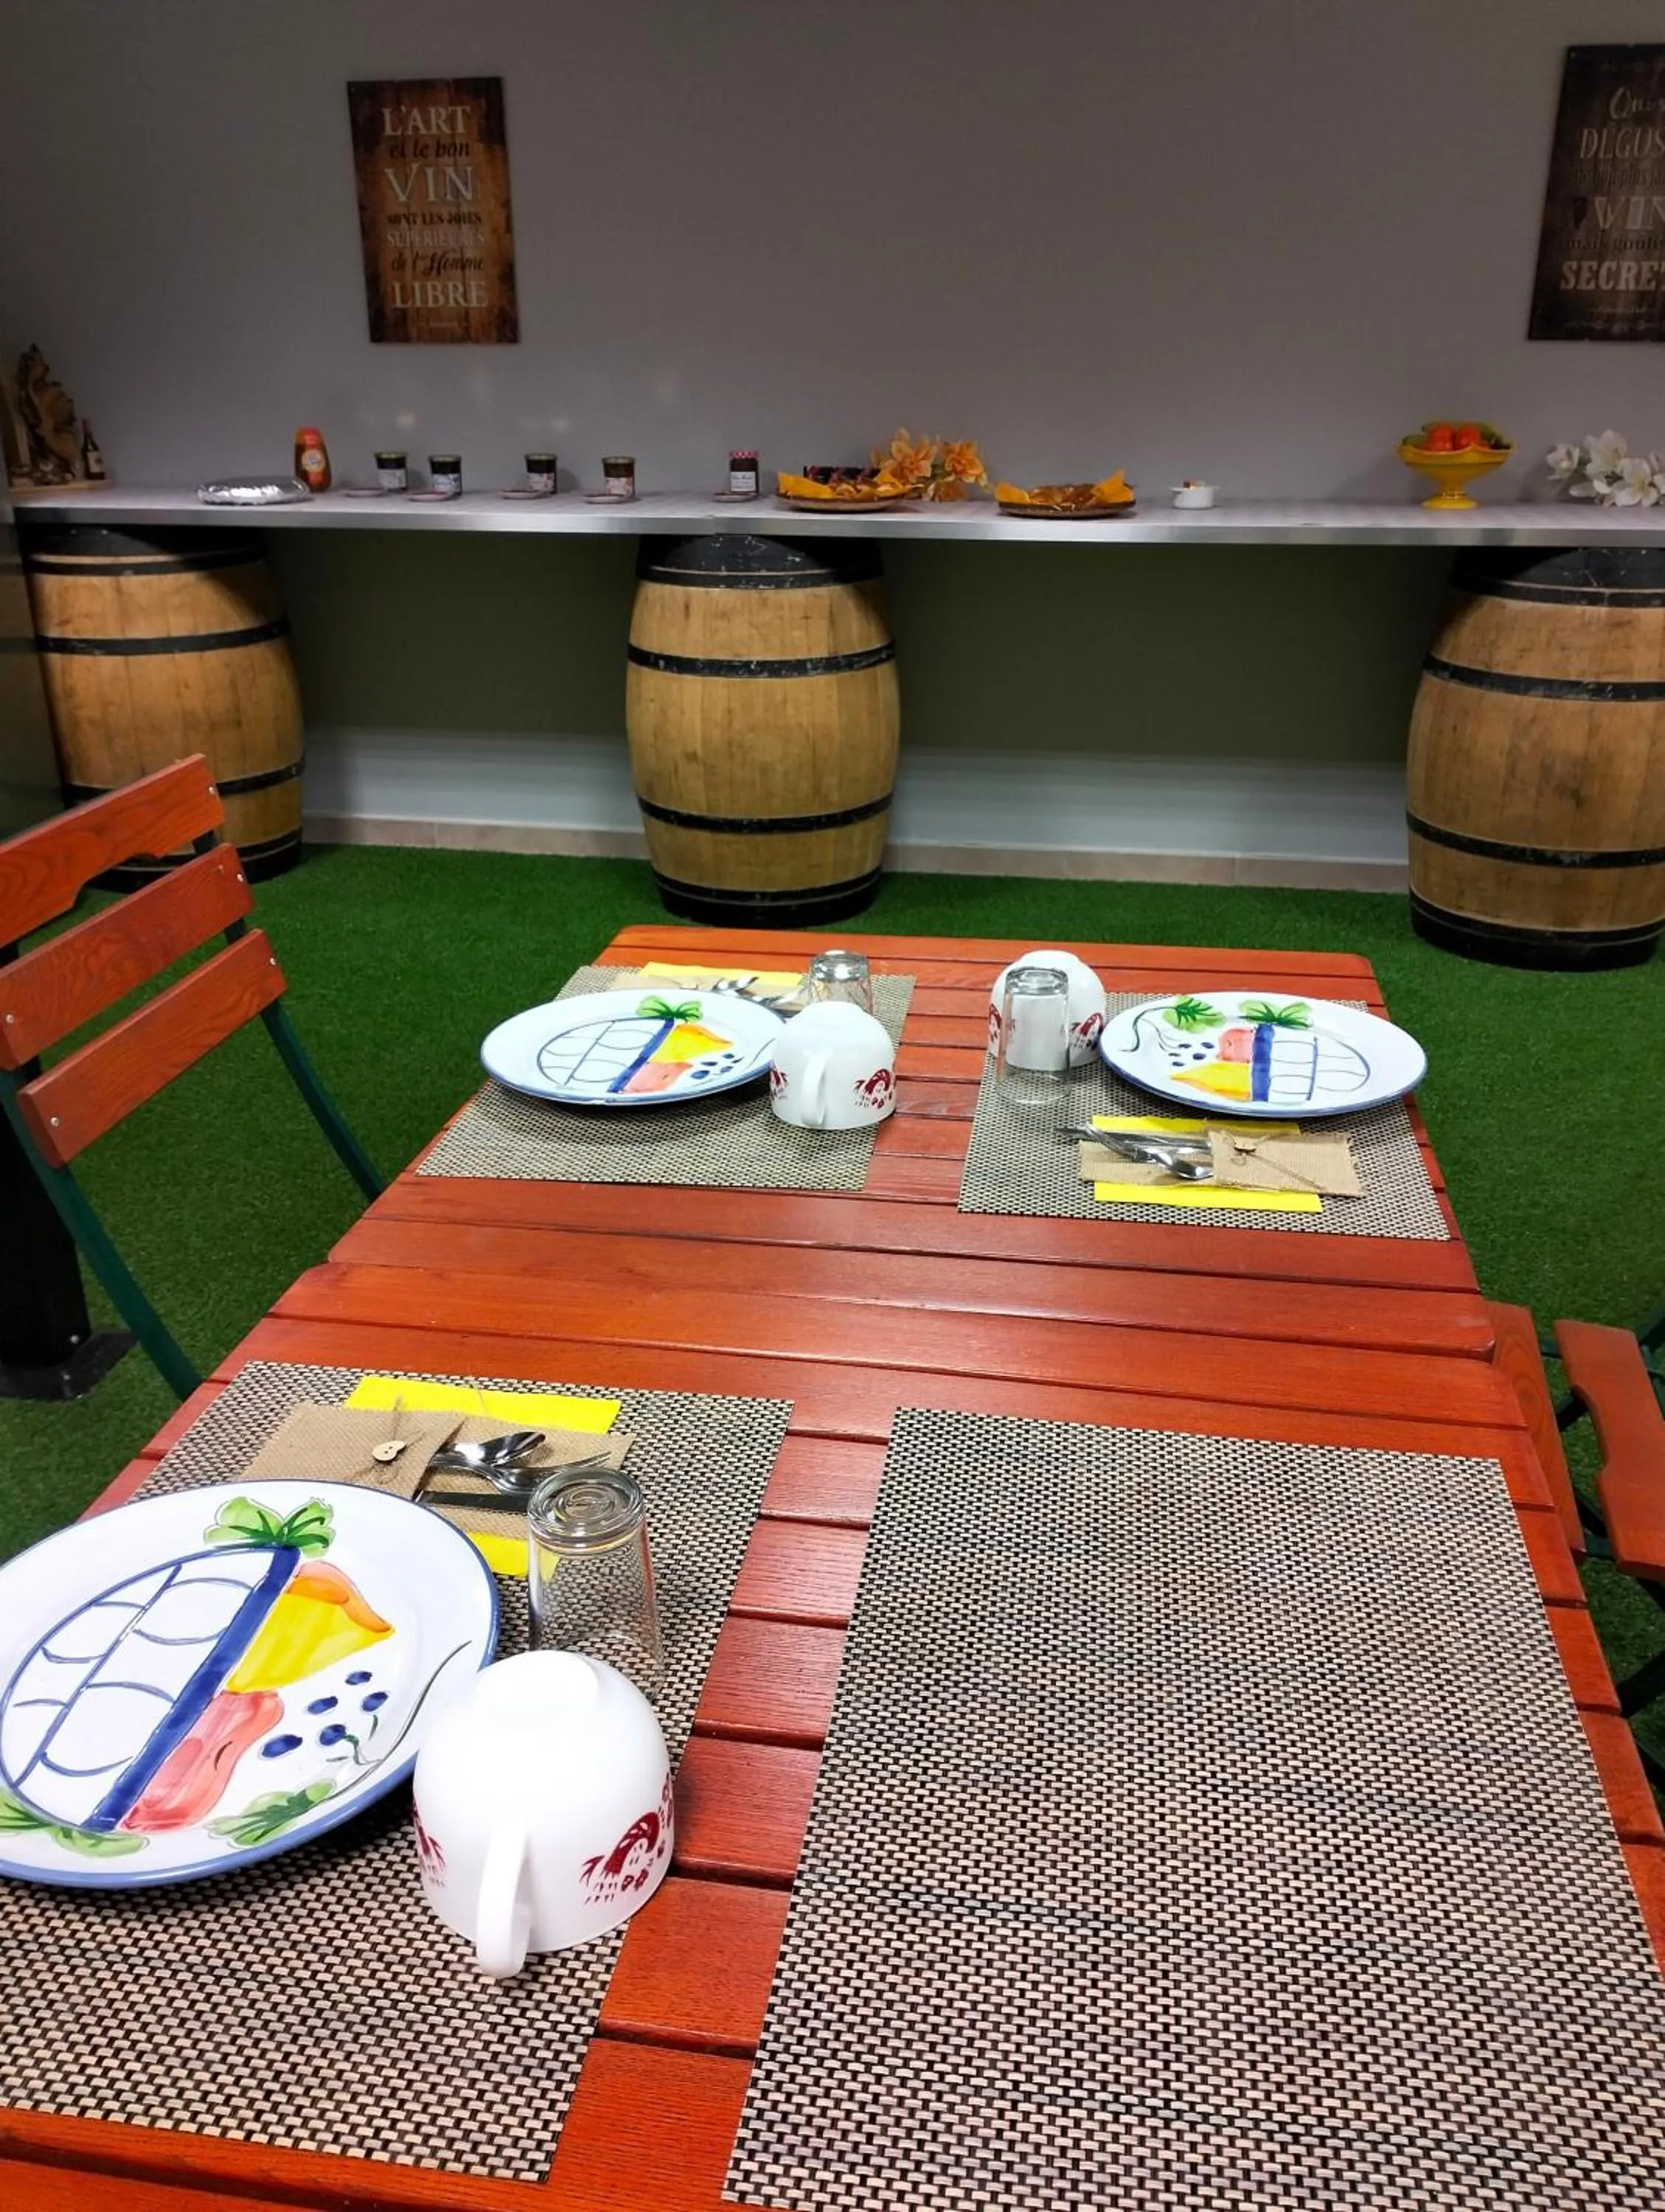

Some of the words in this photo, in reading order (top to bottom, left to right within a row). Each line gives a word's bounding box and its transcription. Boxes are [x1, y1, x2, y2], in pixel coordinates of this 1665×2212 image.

[381, 105, 470, 136] L'ART
[413, 139, 430, 159] le
[435, 140, 470, 159] bon
[384, 161, 473, 201] VIN
[1560, 260, 1665, 291] SECRE
[392, 280, 489, 308] LIBRE
